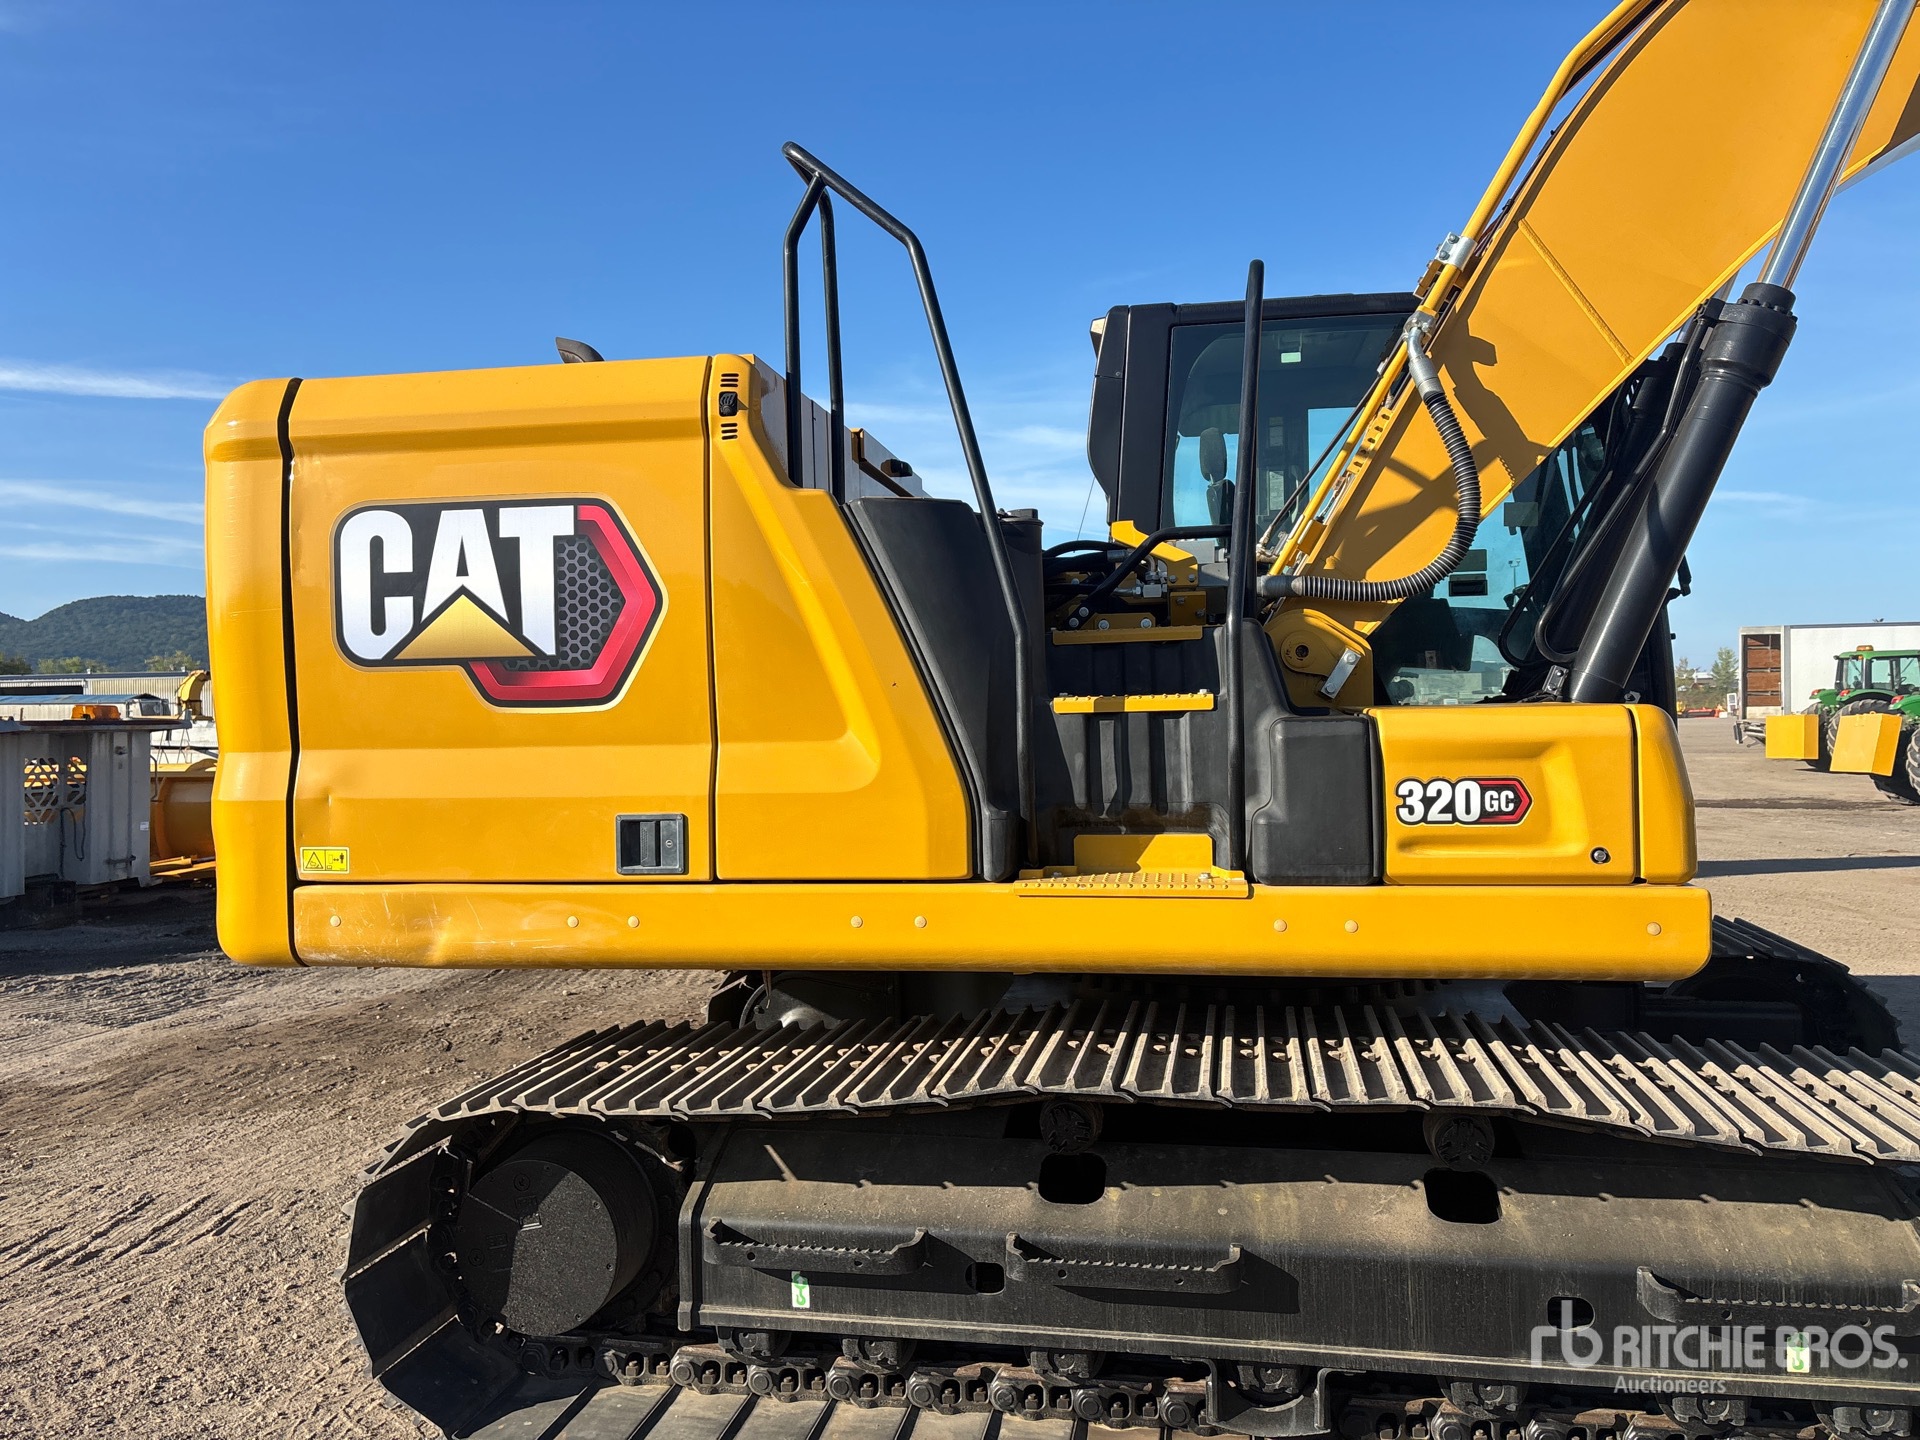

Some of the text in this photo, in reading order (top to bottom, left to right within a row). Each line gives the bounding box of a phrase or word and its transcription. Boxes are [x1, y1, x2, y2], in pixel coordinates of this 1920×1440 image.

[340, 505, 575, 660] CAT
[1398, 780, 1515, 822] 320 GC
